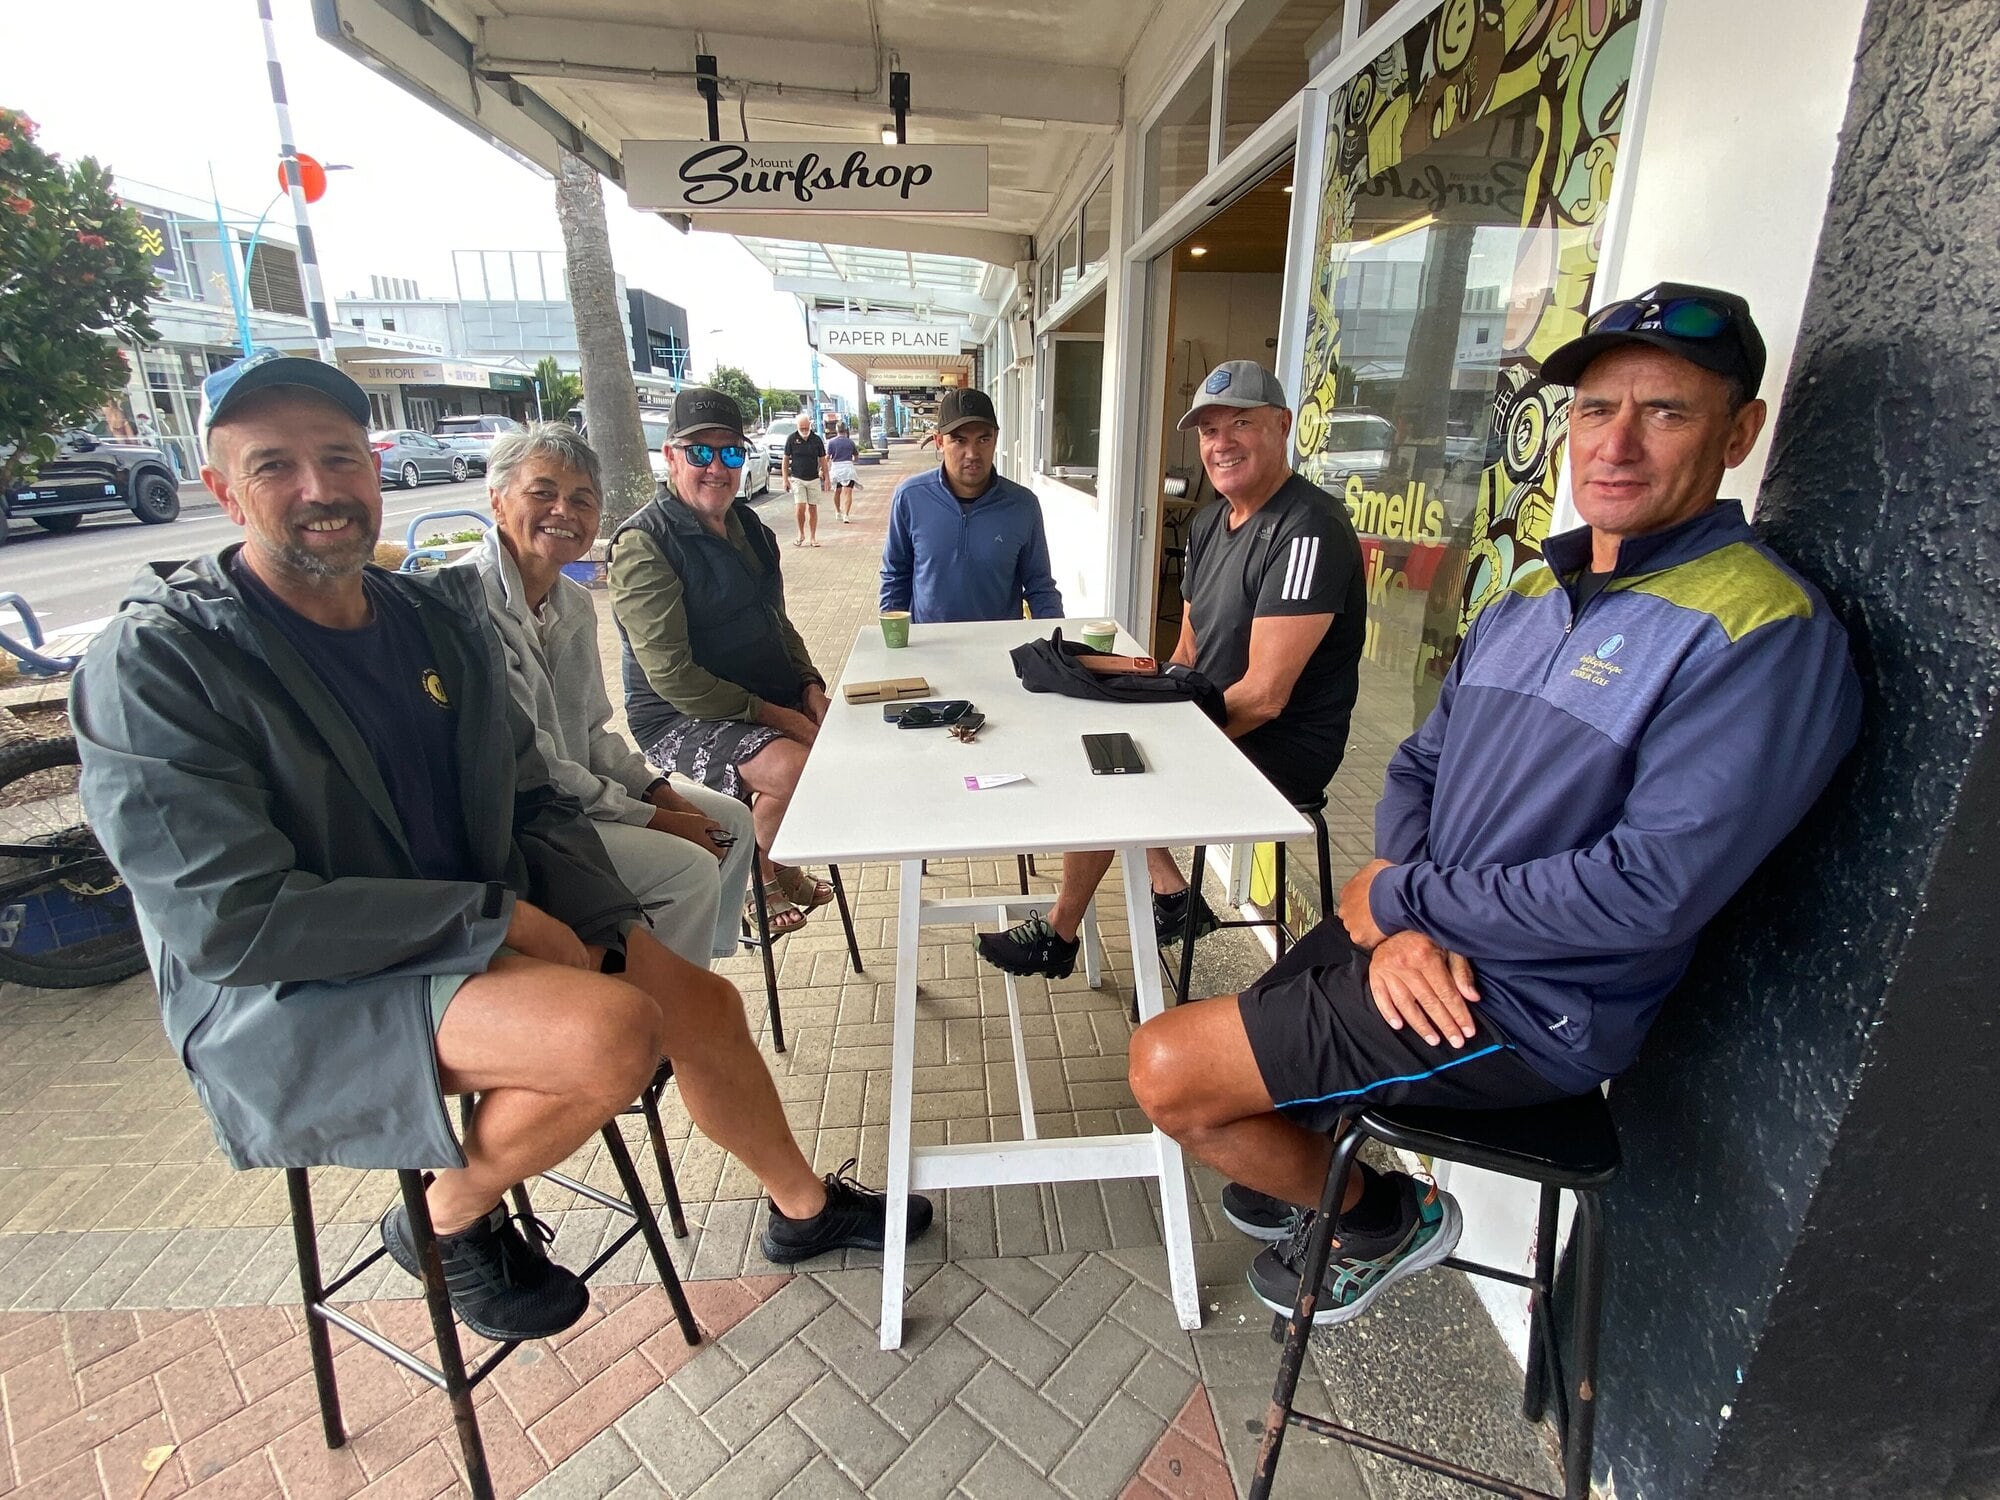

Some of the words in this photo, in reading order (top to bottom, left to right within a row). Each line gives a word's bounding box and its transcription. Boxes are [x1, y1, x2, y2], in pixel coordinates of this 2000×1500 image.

[750, 157, 794, 169] Mount
[678, 144, 933, 205] Surfshop
[829, 331, 885, 346] PAPER
[892, 332, 949, 347] PLANE
[368, 367, 382, 378] SEA
[385, 368, 415, 379] PEOPLE
[1344, 474, 1445, 549] Smells
[1592, 675, 1611, 687] GOLF
